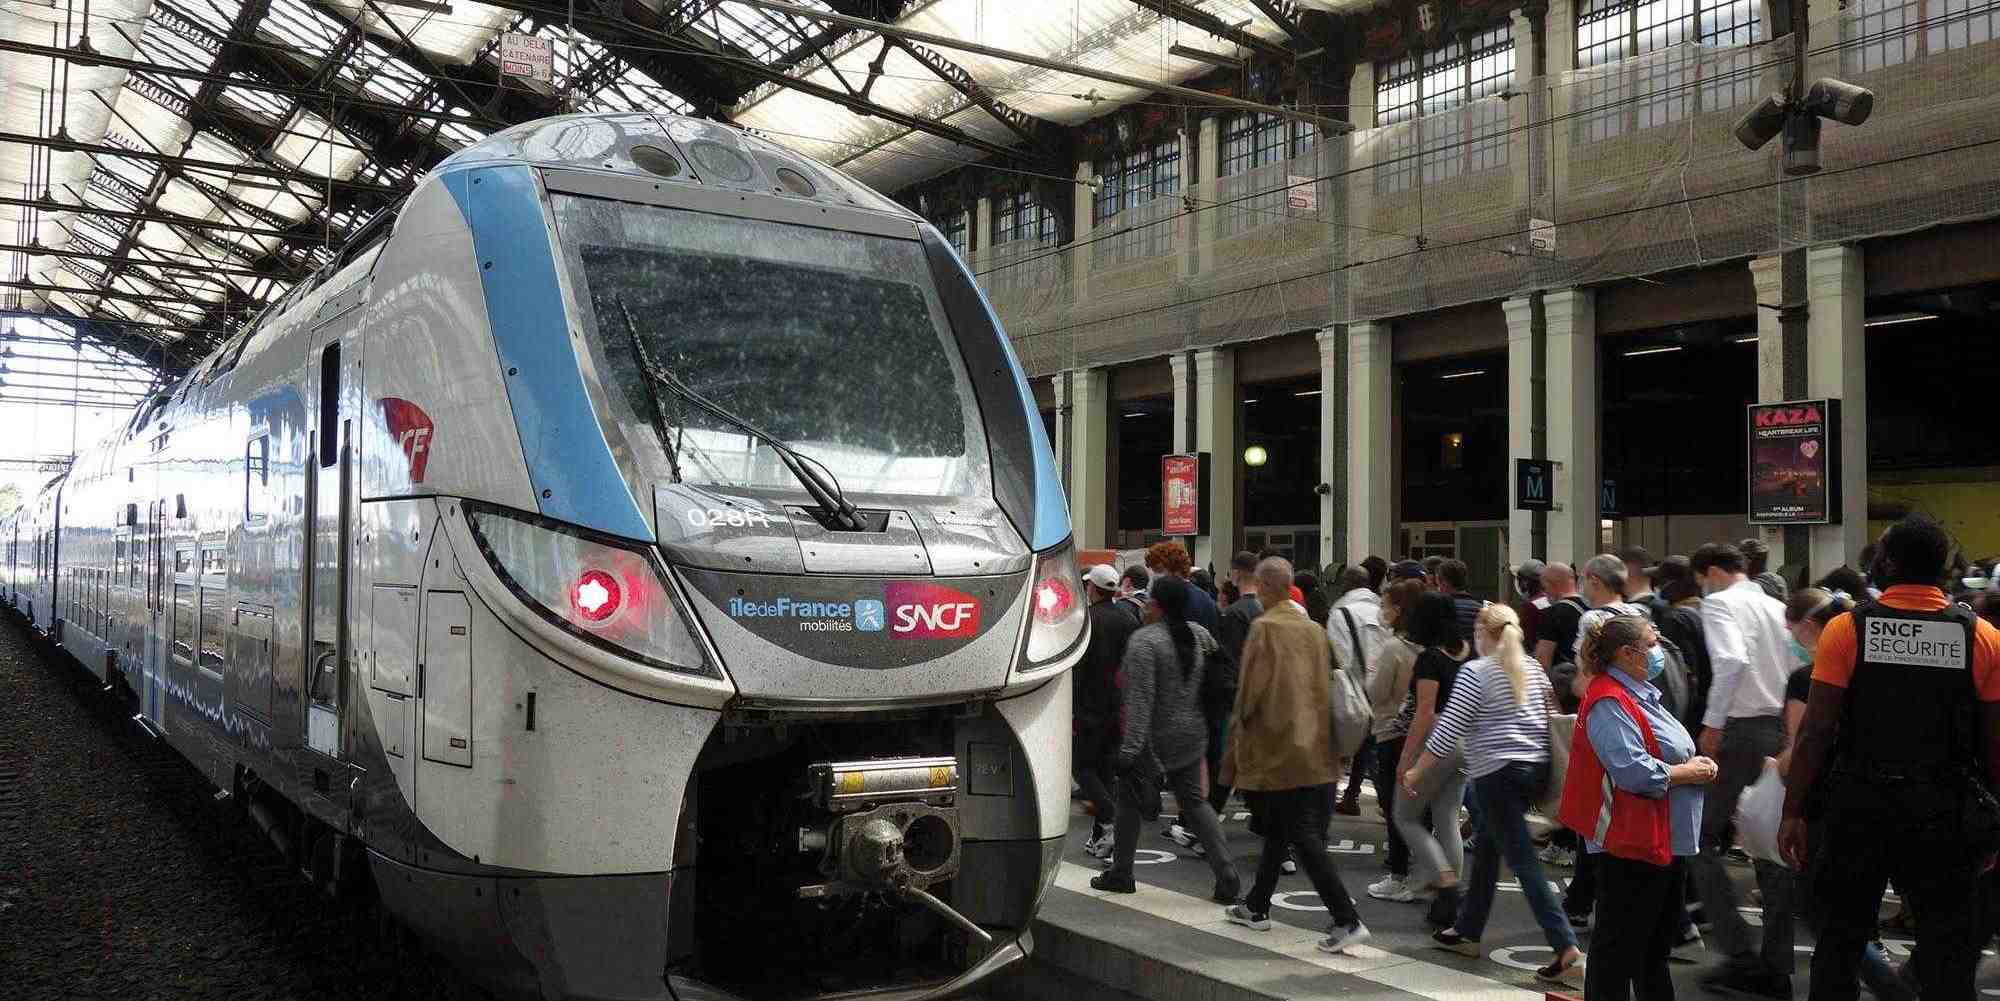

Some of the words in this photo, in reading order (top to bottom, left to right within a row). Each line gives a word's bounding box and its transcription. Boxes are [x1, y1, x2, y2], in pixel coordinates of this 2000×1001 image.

[507, 35, 518, 46] AU
[505, 63, 531, 75] MOINS
[1755, 406, 1822, 427] KAZA
[1526, 475, 1543, 499] M
[687, 508, 770, 528] 028R
[800, 619, 852, 632] mobilités
[893, 603, 975, 632] SNCF
[1870, 621, 1922, 637] SNCF
[1869, 638, 1961, 658] SECURITÉ
